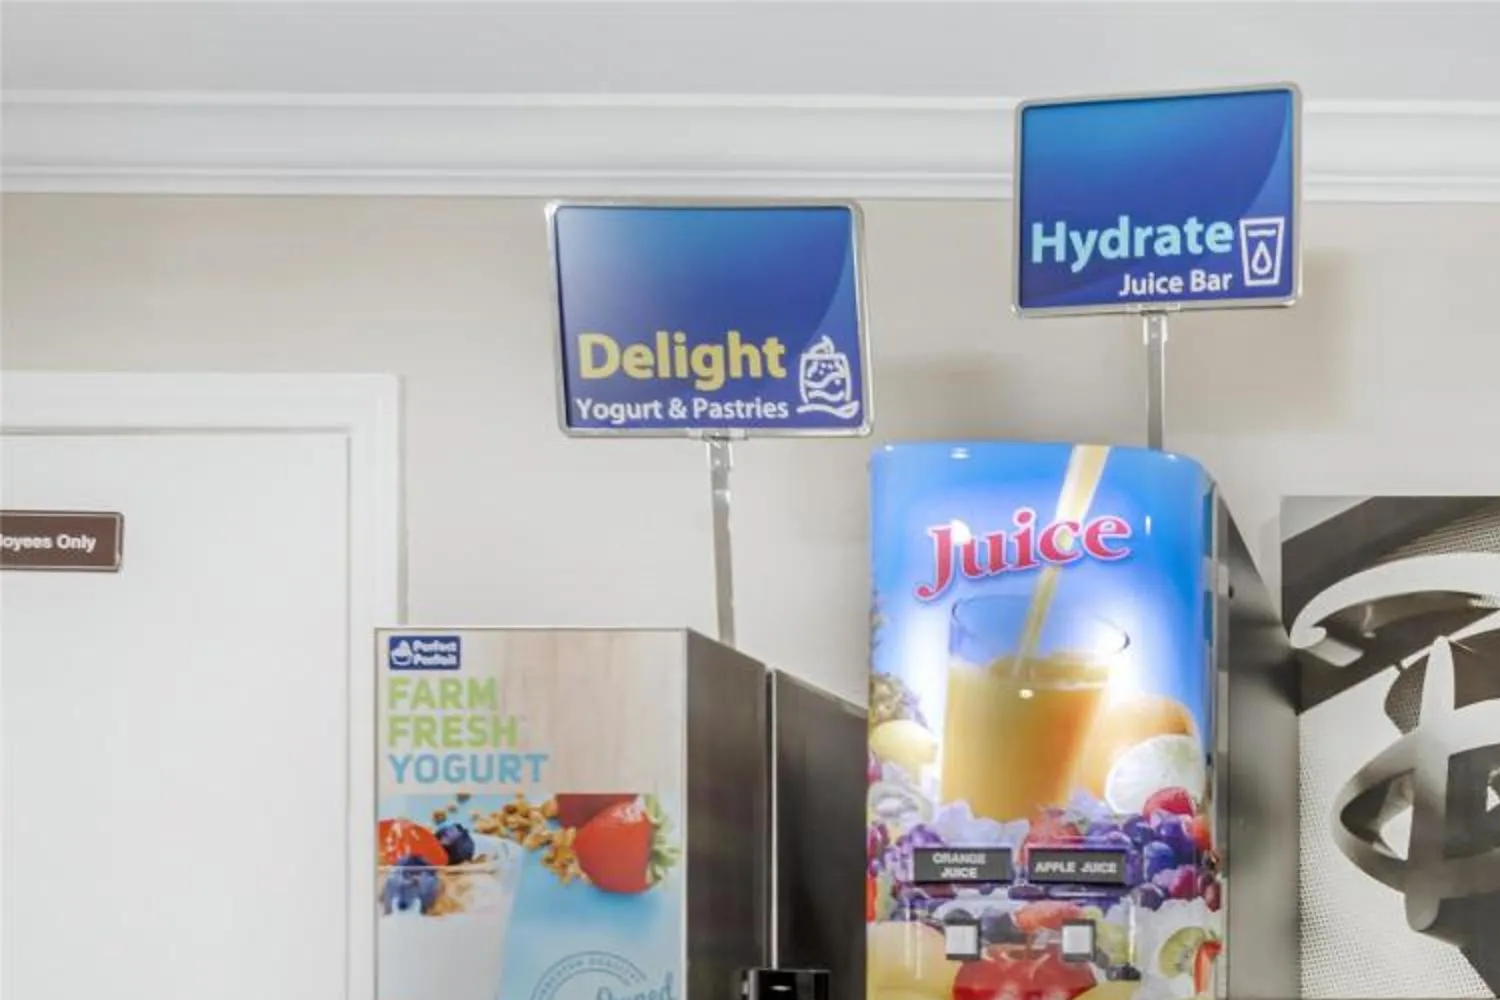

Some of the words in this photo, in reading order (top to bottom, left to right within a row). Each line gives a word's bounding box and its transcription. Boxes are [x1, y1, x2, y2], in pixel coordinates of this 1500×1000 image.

[1031, 214, 1235, 273] Hydrate
[1118, 272, 1184, 297] Juice
[1190, 269, 1233, 292] Bar
[577, 330, 787, 391] Delight
[576, 397, 663, 424] Yogurt
[668, 397, 687, 419] &
[692, 398, 789, 419] Pastries
[56, 533, 97, 553] Only
[914, 507, 1133, 601] Juice
[388, 677, 499, 711] FARM
[388, 714, 519, 748] FRESH
[387, 752, 548, 785] YOGURT
[932, 853, 986, 864] ORANGE
[941, 867, 978, 879] JUICE
[1035, 861, 1076, 873] APPLE
[1081, 861, 1118, 873] JUICE
